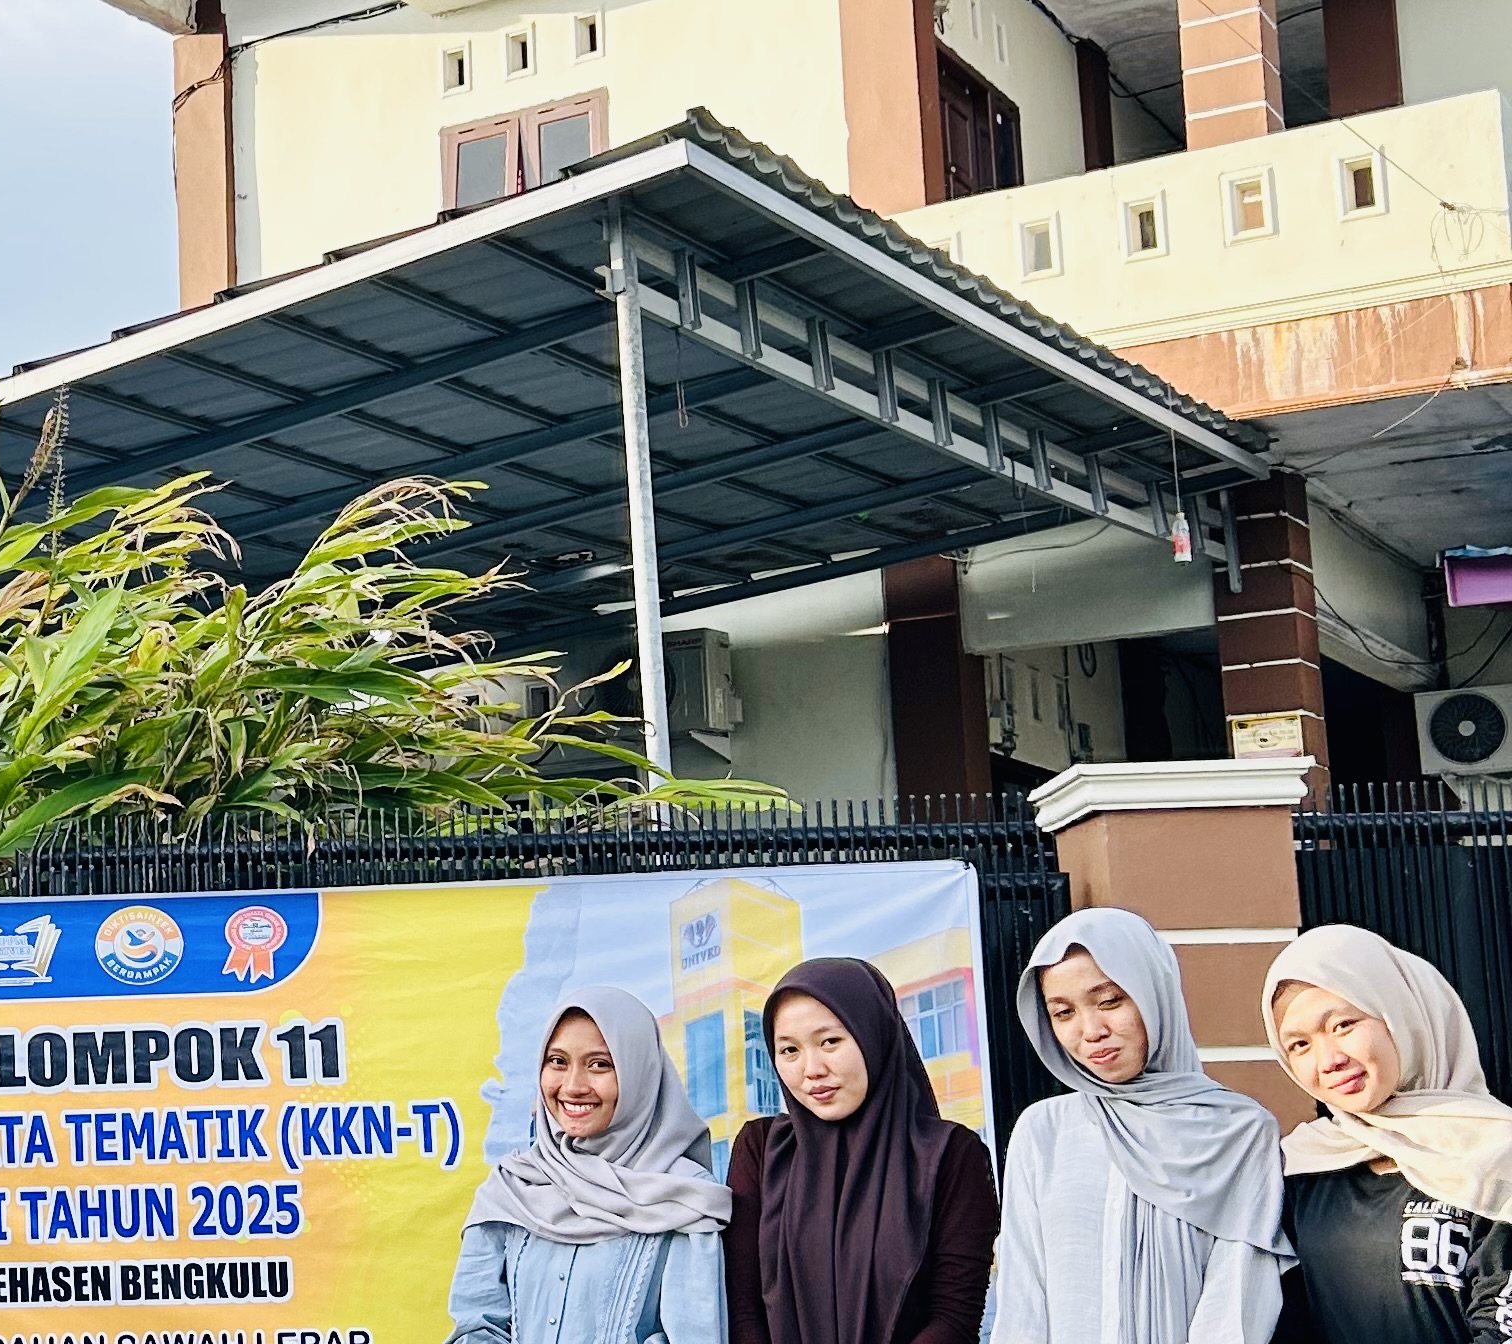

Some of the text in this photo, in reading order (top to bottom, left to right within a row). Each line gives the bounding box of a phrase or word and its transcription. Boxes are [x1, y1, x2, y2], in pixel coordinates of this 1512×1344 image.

[104, 912, 175, 936] DIKTISAINTEK
[107, 958, 173, 980] BERDAMPAK
[277, 1024, 340, 1079] 11
[65, 1109, 267, 1162] TEMATIK
[281, 1101, 460, 1170] (KKN-T)
[20, 1188, 175, 1240] TAHUN
[191, 1184, 300, 1236] 2025
[1401, 1217, 1472, 1276] 86
[120, 1261, 289, 1302] BENGKULU
